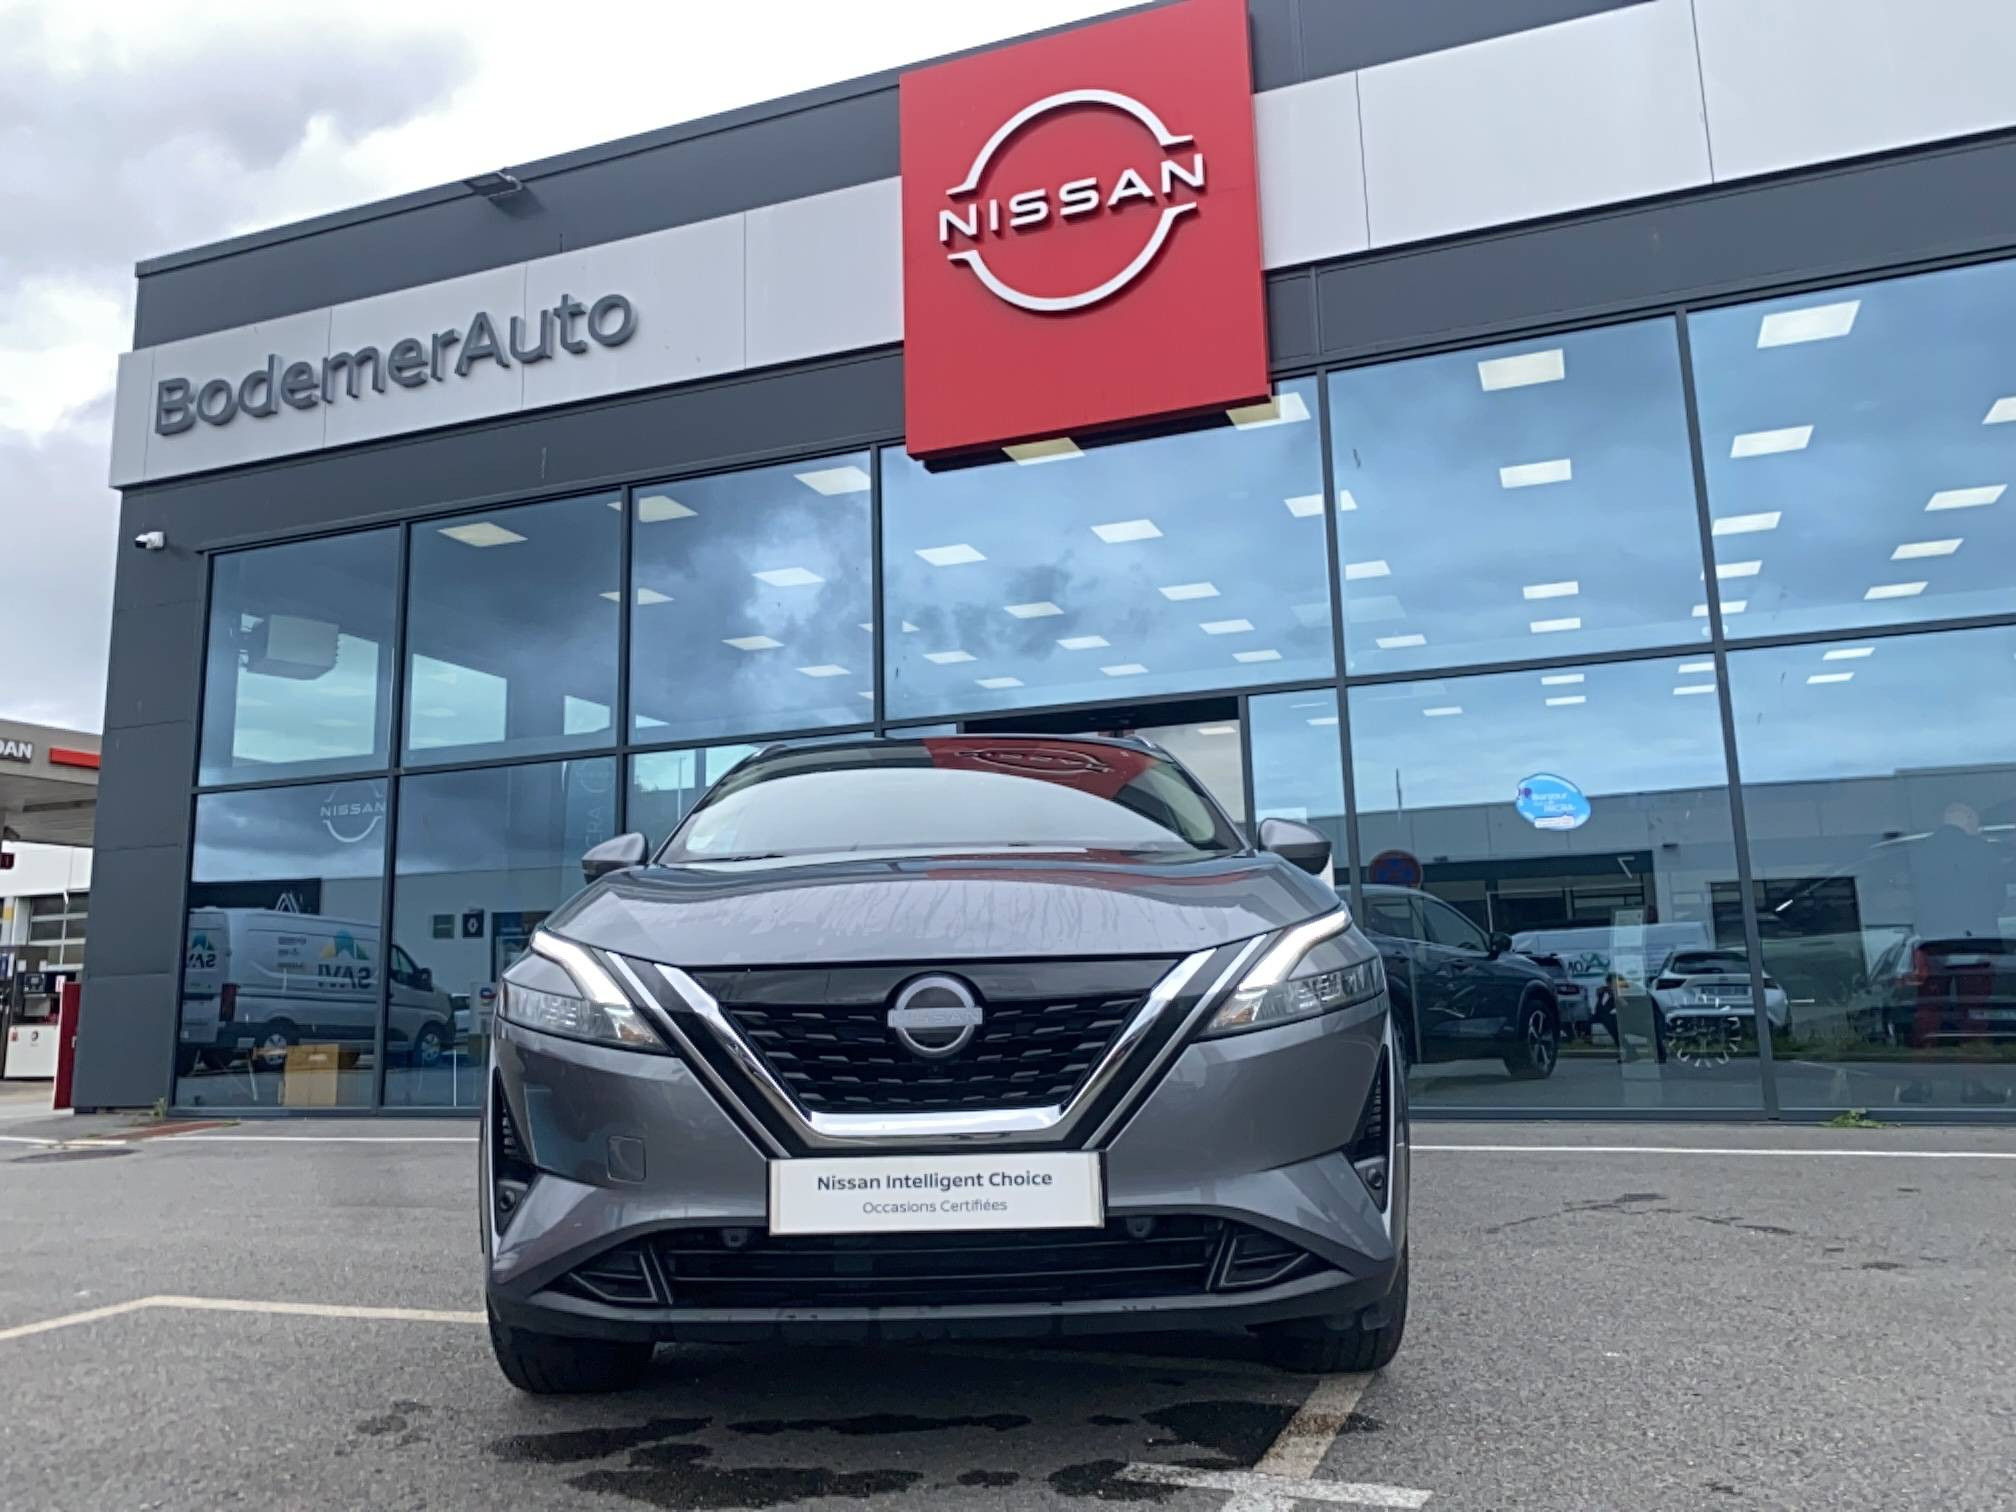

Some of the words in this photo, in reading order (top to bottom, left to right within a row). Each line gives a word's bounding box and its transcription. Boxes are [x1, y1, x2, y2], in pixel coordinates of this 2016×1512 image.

[939, 153, 1205, 242] NISSAN
[156, 293, 638, 437] BodemerAuto
[320, 801, 386, 817] NISSAN
[584, 806, 604, 848] CRA
[816, 1175, 881, 1191] Nissan
[886, 1172, 984, 1192] Intelligent
[988, 1170, 1053, 1187] Choice
[862, 1201, 937, 1214] Occasions
[940, 1199, 1008, 1213] Certifiées
